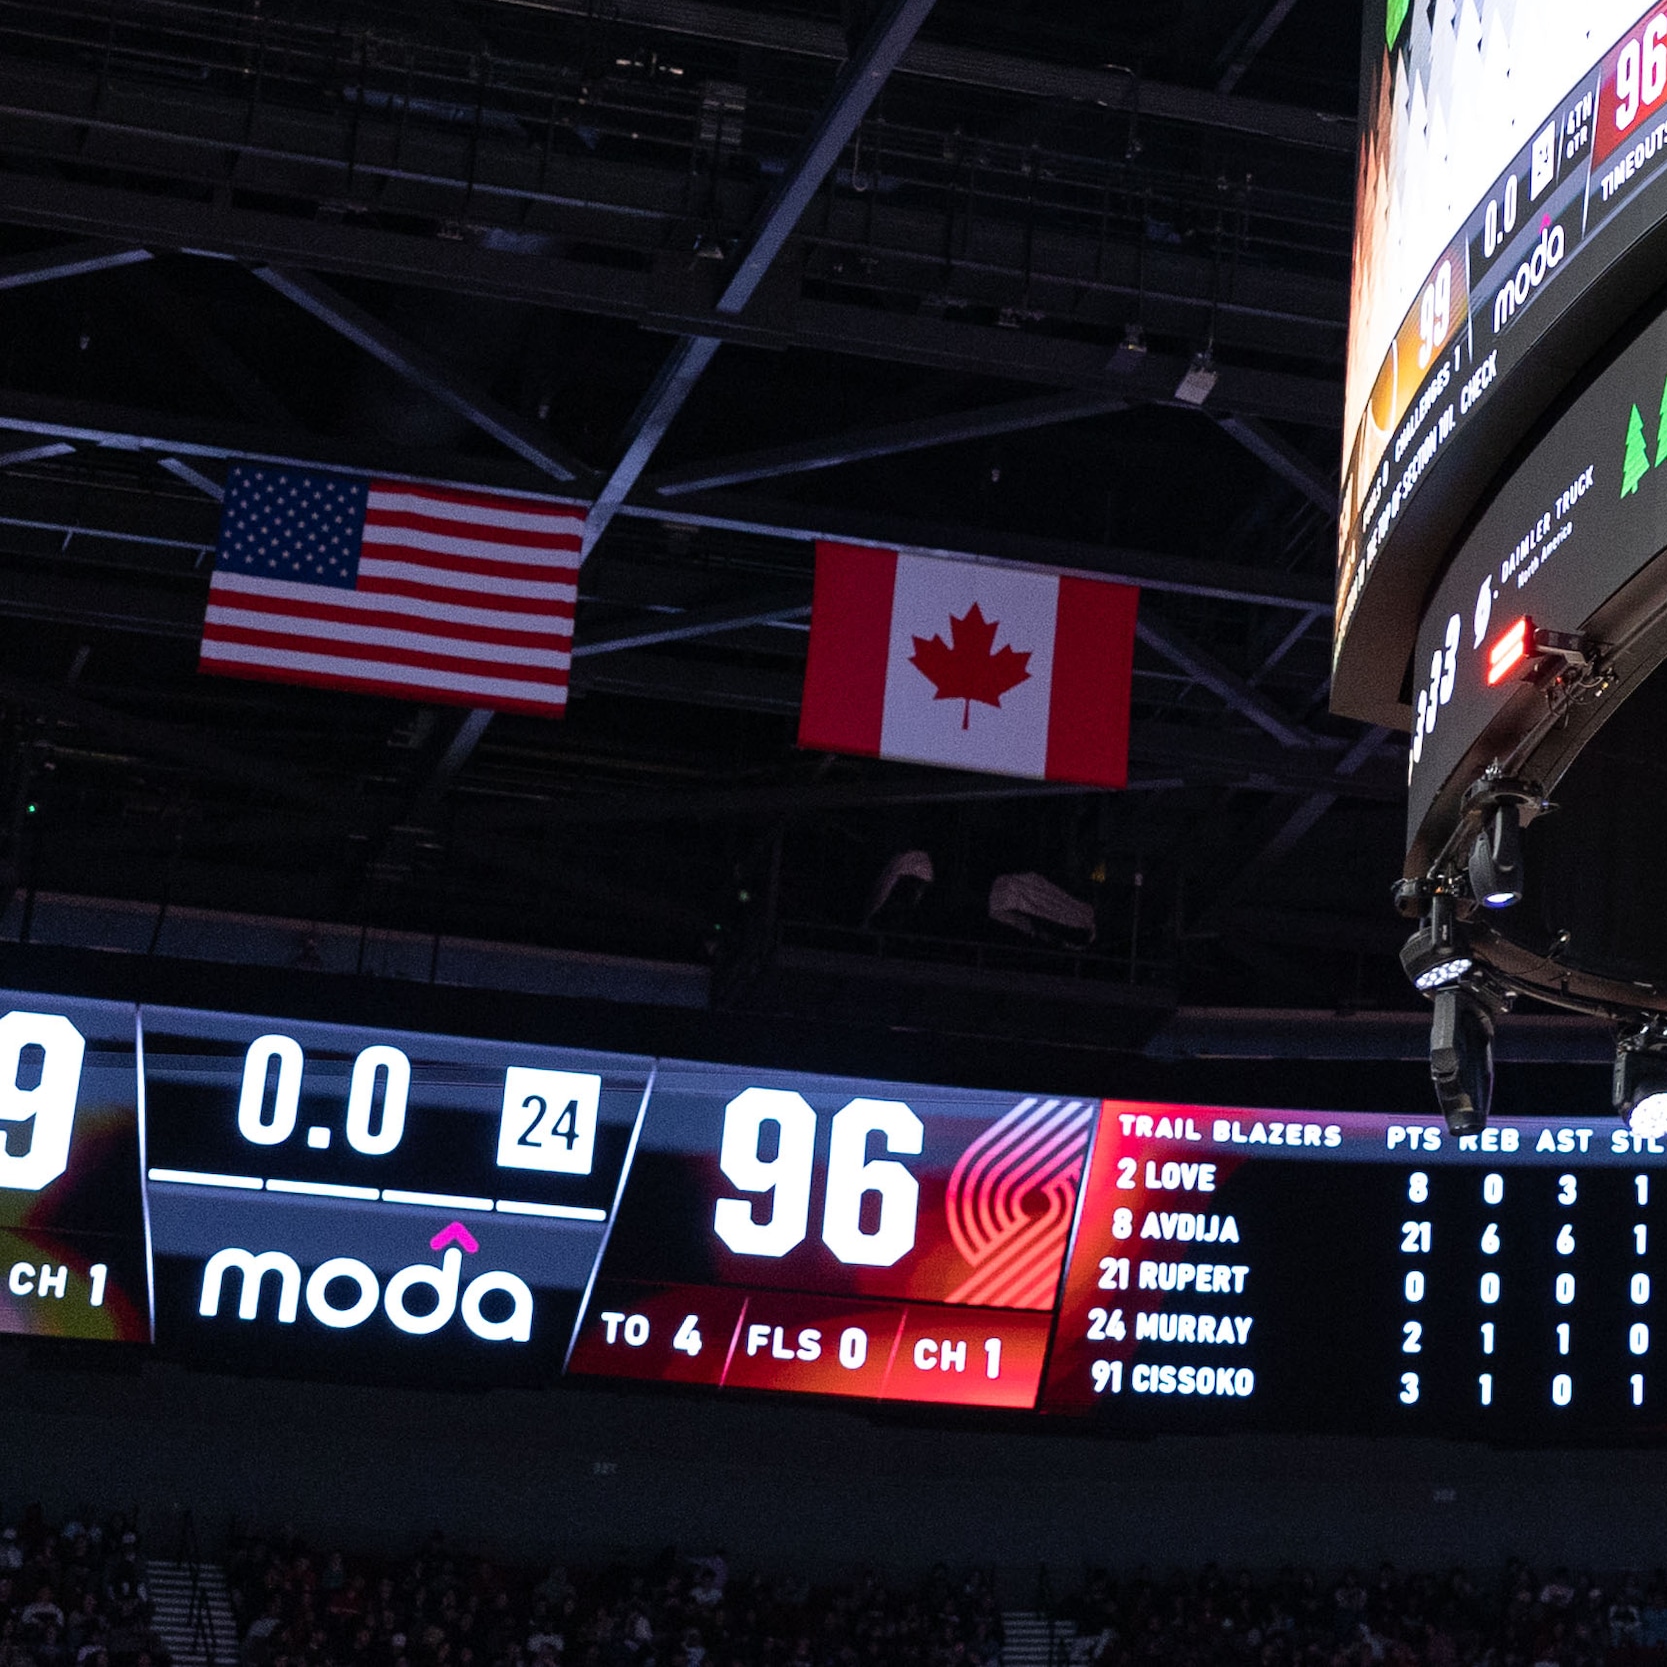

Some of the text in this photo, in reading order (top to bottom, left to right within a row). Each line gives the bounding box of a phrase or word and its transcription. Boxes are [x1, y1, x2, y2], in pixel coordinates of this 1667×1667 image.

[1615, 12, 1667, 131] 96
[1483, 173, 1518, 258] 0.0
[1493, 214, 1565, 333] moda
[1419, 260, 1451, 370] 99
[1460, 349, 1498, 415] CHECK
[1501, 464, 1594, 584] DAIMLER TRUCK
[0, 1010, 86, 1191] 9
[238, 1034, 581, 1155] 0.0 24
[1118, 1113, 1342, 1147] TRAIL BLAZERS
[1387, 1125, 1442, 1151] PTS
[1459, 1128, 1521, 1153] REB
[1535, 1128, 1594, 1153] AST
[1610, 1130, 1666, 1156] STL
[713, 1087, 924, 1267] 96
[1116, 1157, 1137, 1190] 2
[1145, 1160, 1217, 1192] LOVE
[1408, 1171, 1428, 1203] 8
[1558, 1174, 1577, 1205] 3
[1635, 1174, 1648, 1205] 1
[1111, 1207, 1133, 1240] 8
[1140, 1211, 1240, 1243] AVDIJA
[1400, 1221, 1432, 1253] 21
[1481, 1223, 1500, 1254] 6
[1556, 1224, 1575, 1255] 6
[1633, 1224, 1647, 1255] 1
[8, 1262, 107, 1307] CH 1
[199, 1221, 535, 1342] moda
[1098, 1256, 1130, 1290] 21
[1138, 1260, 1250, 1293] RUPERT
[600, 1311, 703, 1356] TO 4
[747, 1324, 868, 1370] FLS 0
[1086, 1307, 1127, 1341] 24
[1135, 1312, 1253, 1345] MURRAY
[1402, 1321, 1422, 1353] 2
[1480, 1322, 1494, 1354] 1
[1556, 1323, 1570, 1355] 1
[913, 1337, 1002, 1379] CH 1
[1091, 1359, 1123, 1393] 91
[1132, 1364, 1254, 1397] CISSOKO
[1399, 1372, 1419, 1404] 3
[1478, 1373, 1492, 1405] 1
[1630, 1373, 1643, 1406] 1
